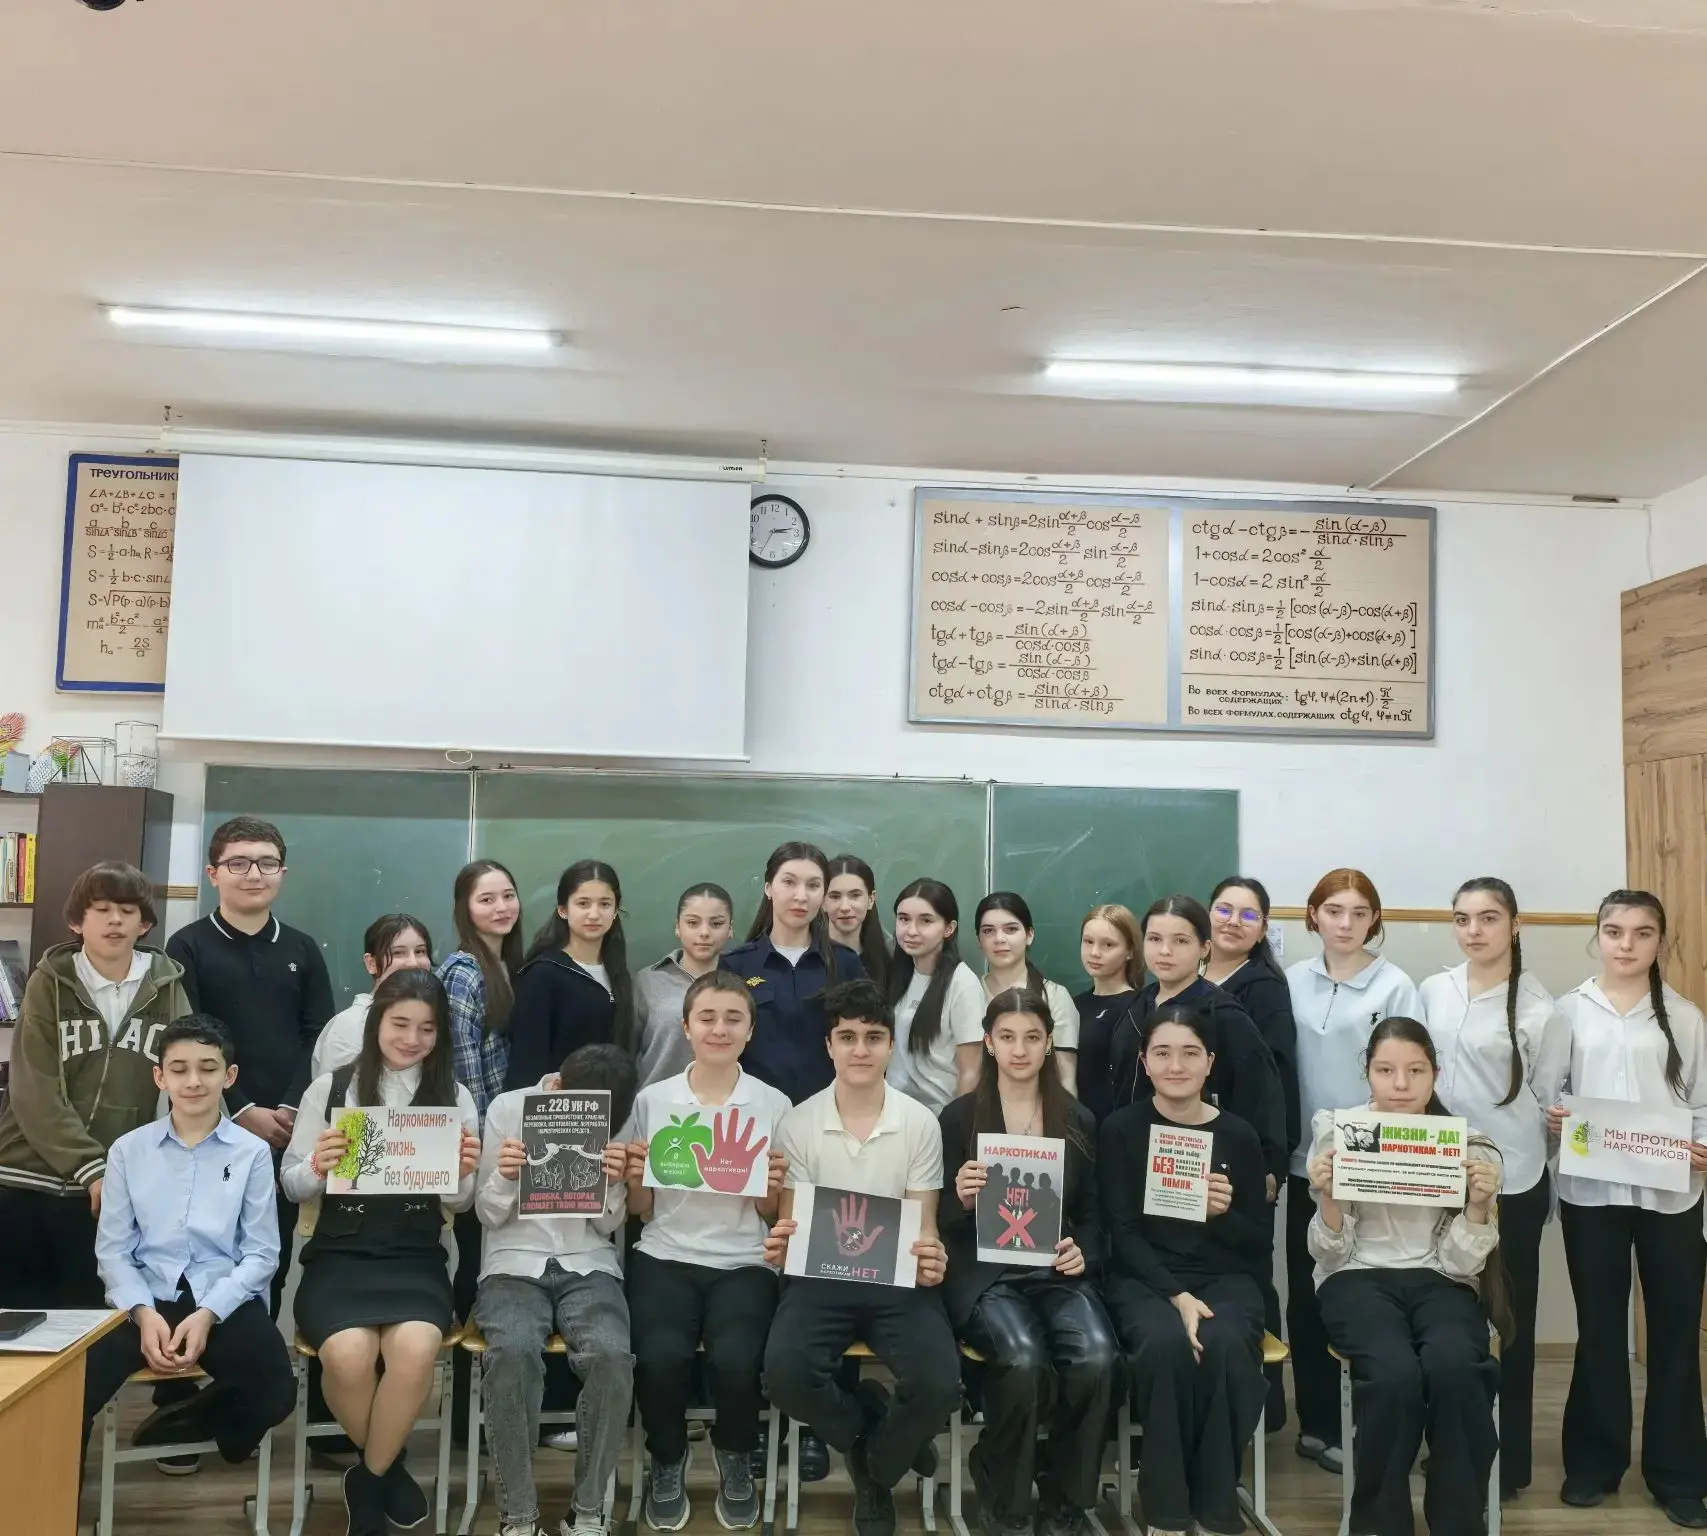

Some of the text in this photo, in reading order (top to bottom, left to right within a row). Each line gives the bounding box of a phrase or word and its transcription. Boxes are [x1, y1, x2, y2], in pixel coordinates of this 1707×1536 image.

[771, 504, 780, 512] 12
[792, 518, 797, 526] 2
[548, 1098, 570, 1112] 228
[584, 1100, 599, 1112] РФ
[388, 1109, 446, 1132] Наркомания
[1382, 1126, 1427, 1142] ЖИЗНИ
[1437, 1130, 1460, 1145] ДА!
[1604, 1128, 1626, 1140] МЫ
[386, 1141, 416, 1156] жизнь
[984, 1146, 1058, 1160] НАРКОТИКАМ
[1382, 1144, 1436, 1155] НАРКОТИКАМ
[1442, 1148, 1460, 1157] НЕТ!
[1604, 1140, 1688, 1160] НАРКОТИКОВ!
[704, 1166, 748, 1174] наркотикам!
[1152, 1156, 1175, 1174] БЕЗ
[384, 1166, 450, 1190] без будущего
[821, 1264, 848, 1272] СКАЖИ
[852, 1266, 880, 1279] НЕТ
